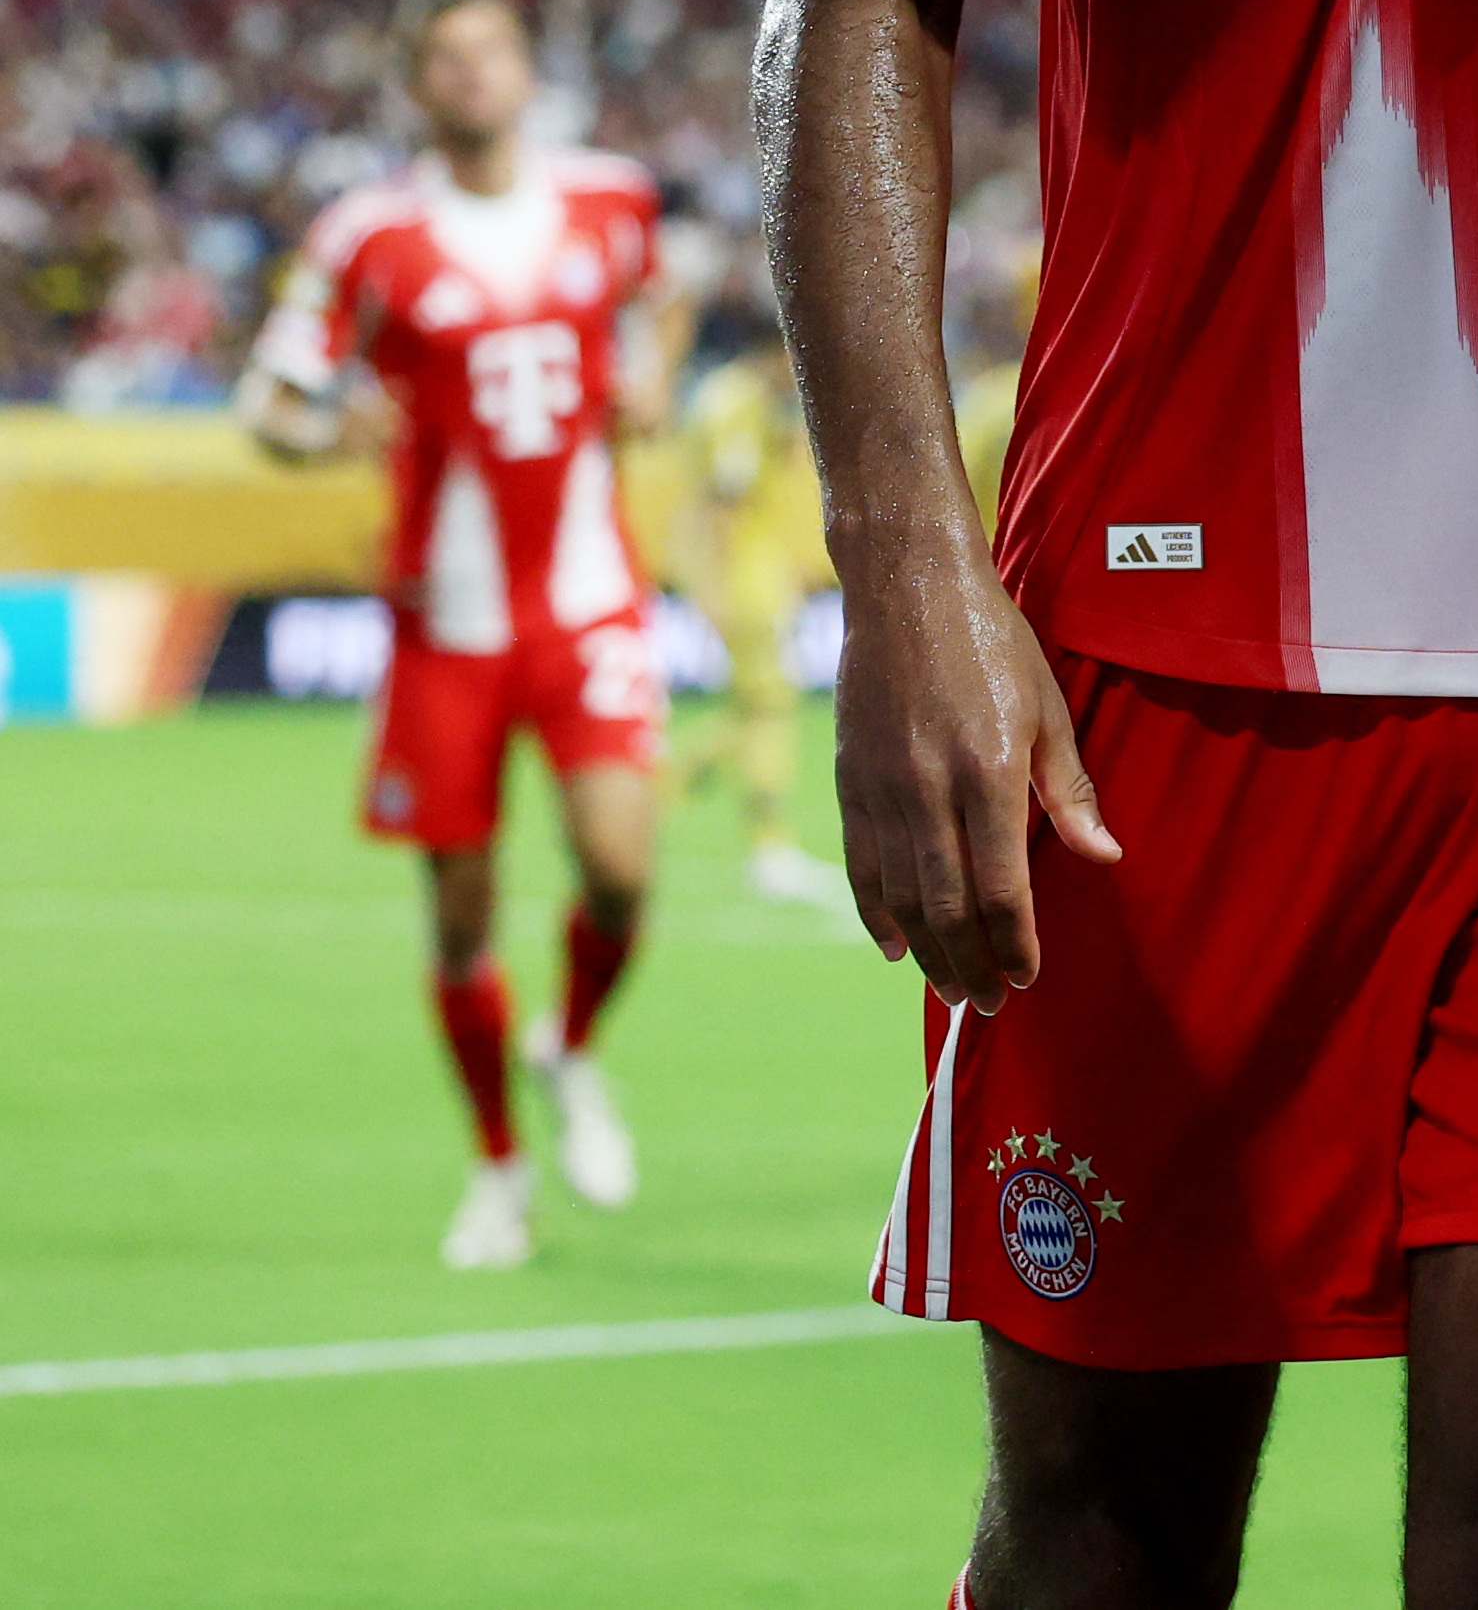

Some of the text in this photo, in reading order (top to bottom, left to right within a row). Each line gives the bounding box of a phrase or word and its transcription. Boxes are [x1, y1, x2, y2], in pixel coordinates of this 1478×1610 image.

[1006, 1176, 1089, 1238] FC BAYERN
[1006, 1232, 1088, 1291] MÜNCHEN
